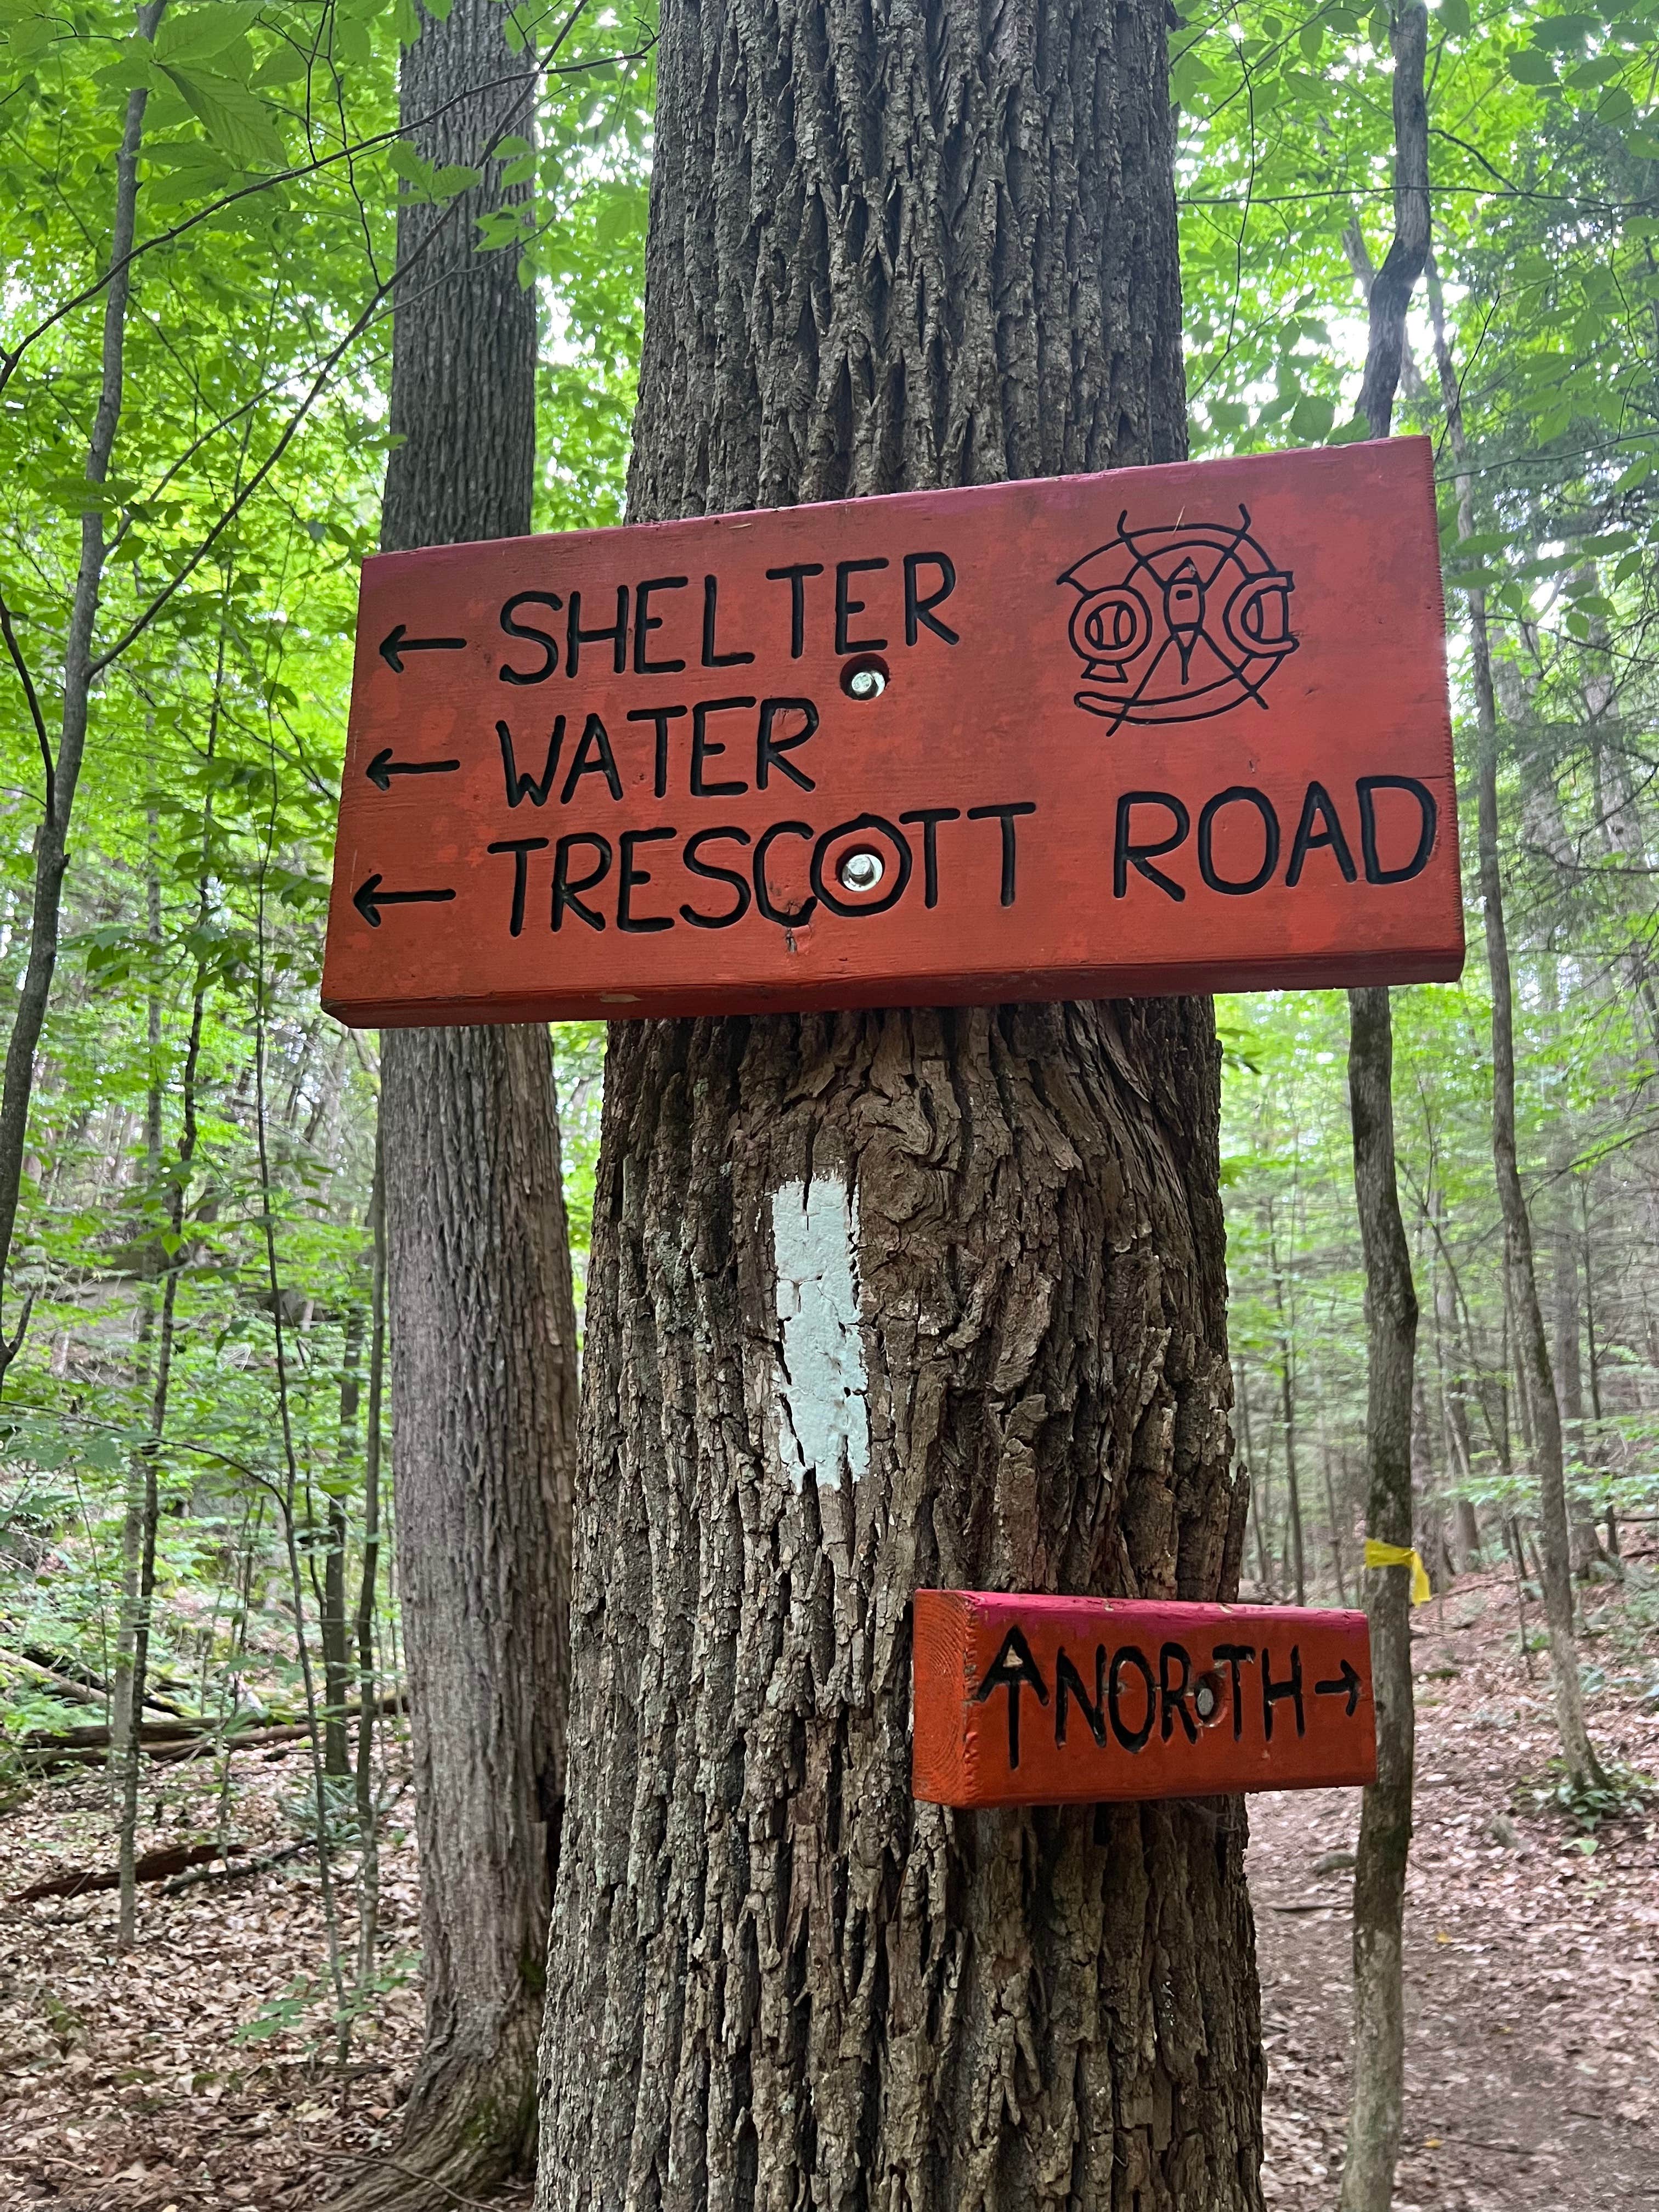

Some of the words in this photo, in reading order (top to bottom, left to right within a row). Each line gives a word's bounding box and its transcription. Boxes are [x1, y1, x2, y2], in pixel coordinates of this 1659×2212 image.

[498, 550, 960, 687] SHELTER
[494, 695, 821, 809] WATER
[486, 805, 1037, 939] TRESCOTT
[1112, 774, 1438, 903] ROAD
